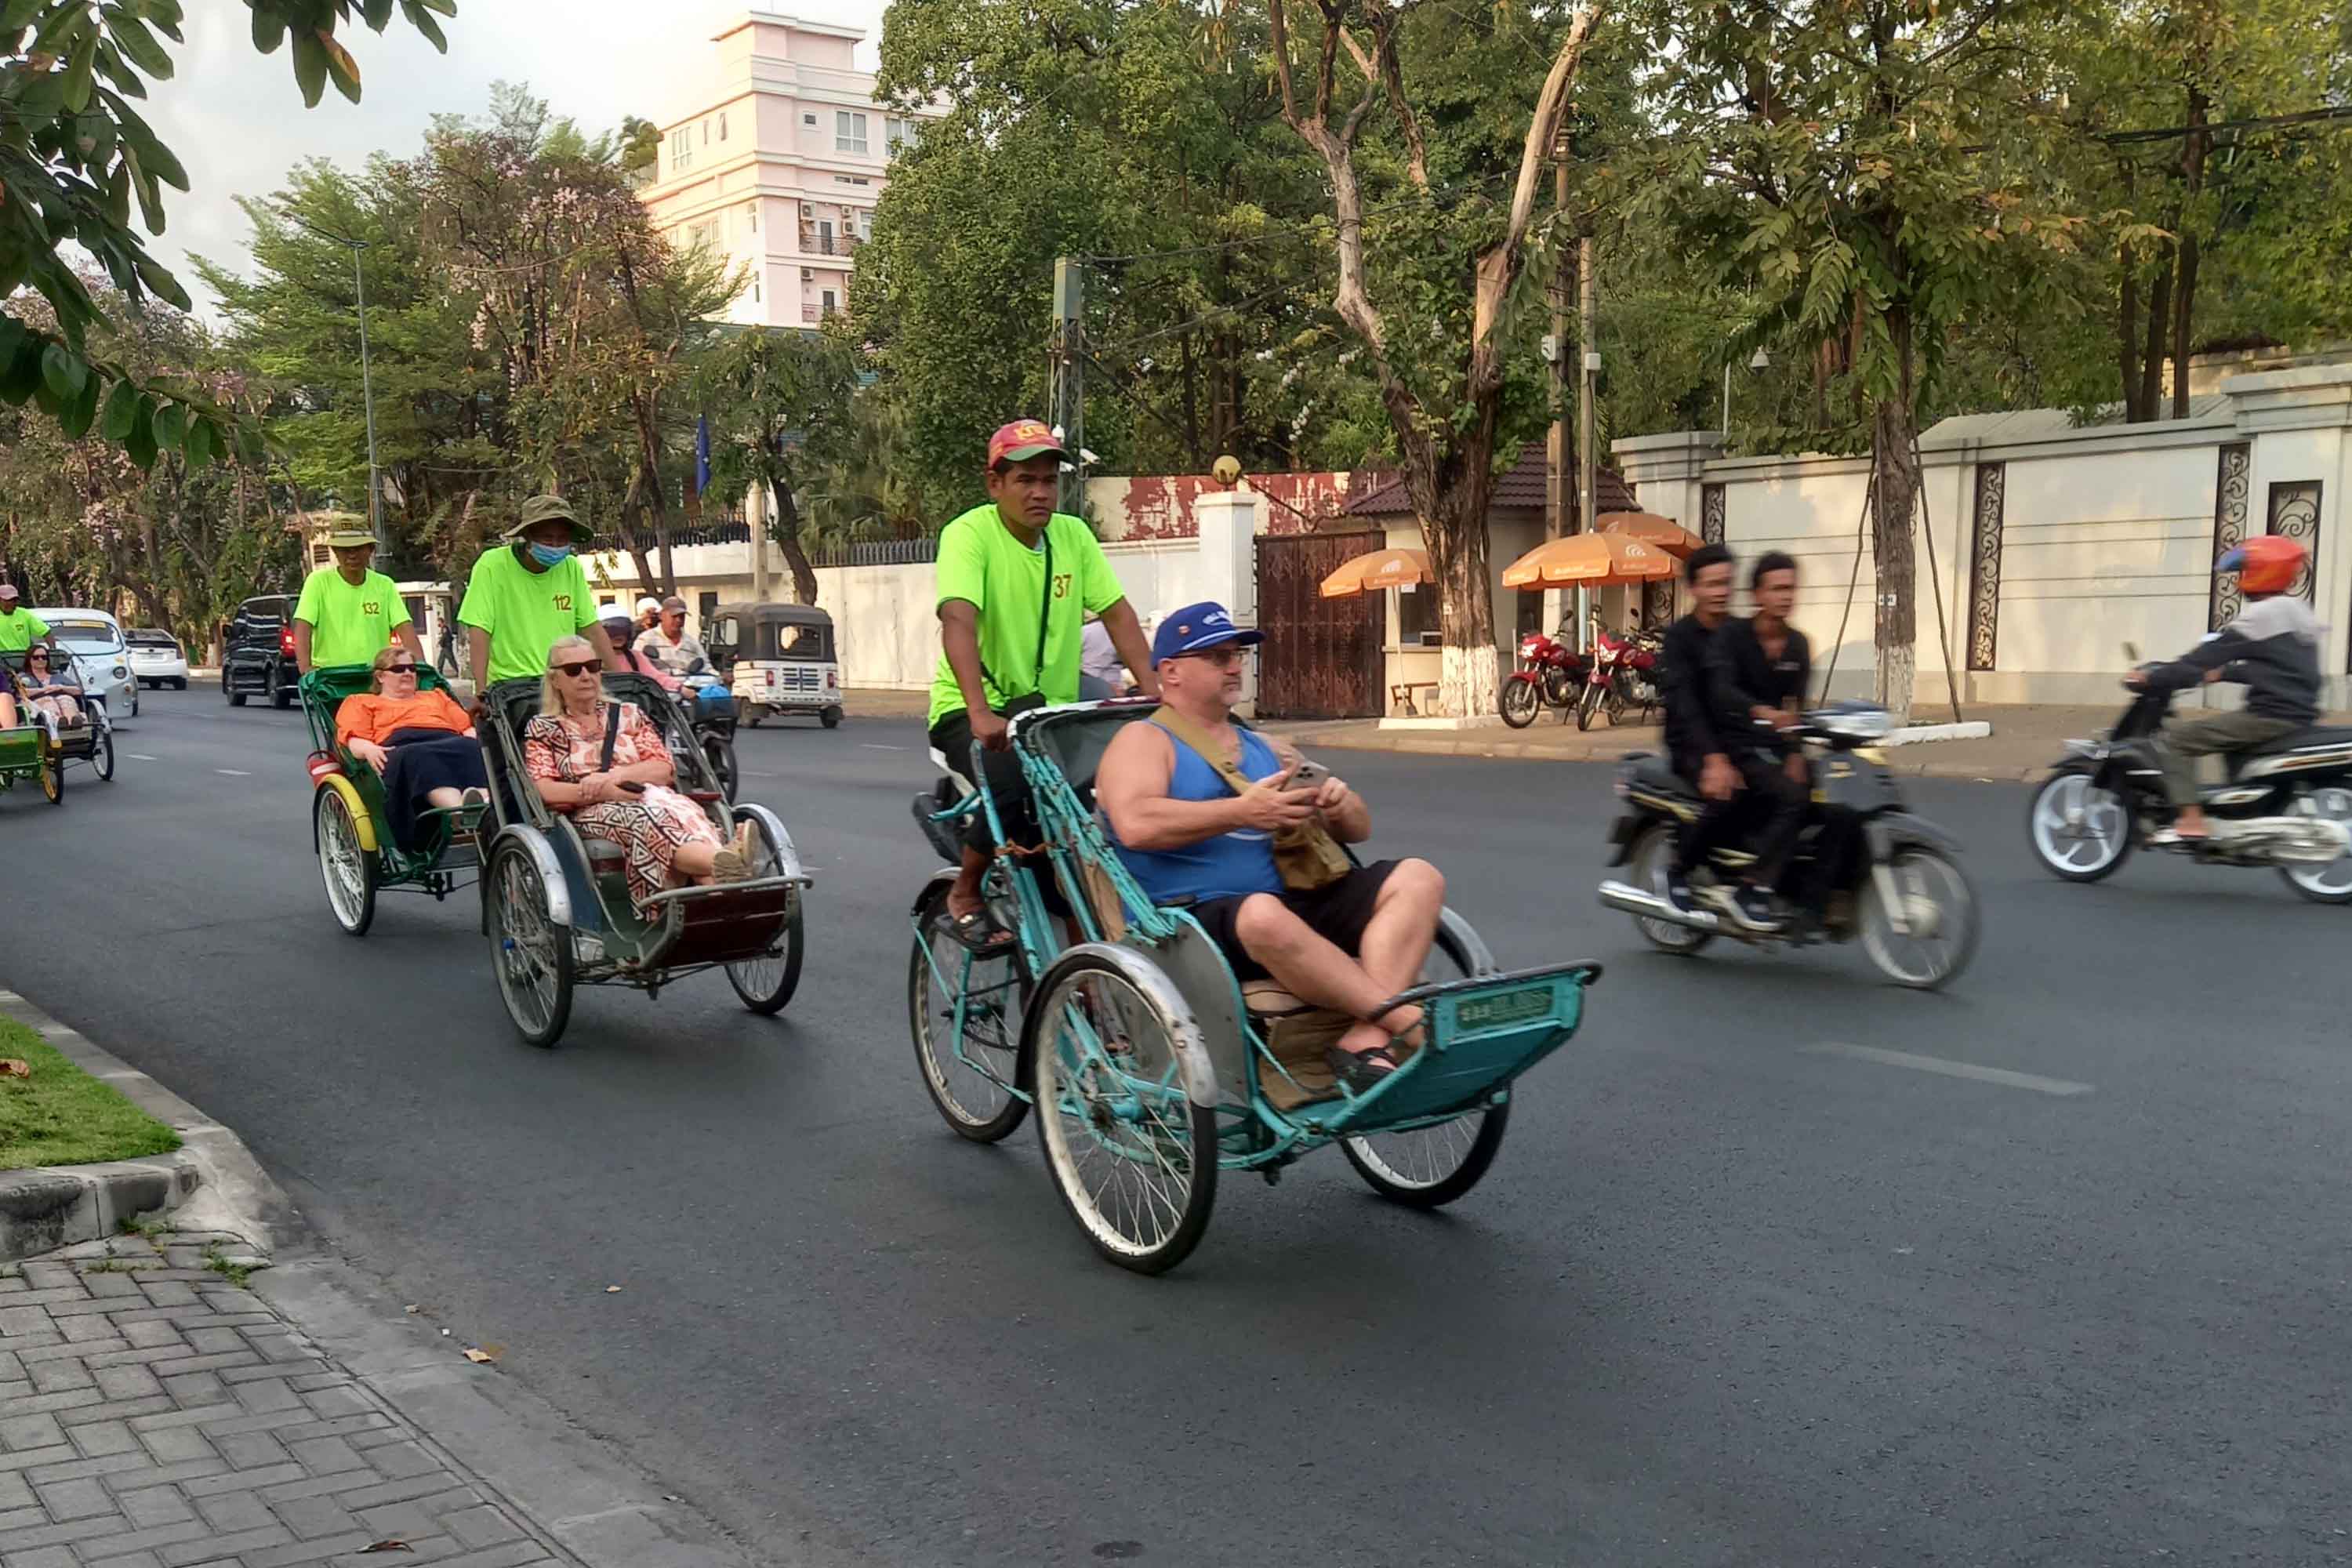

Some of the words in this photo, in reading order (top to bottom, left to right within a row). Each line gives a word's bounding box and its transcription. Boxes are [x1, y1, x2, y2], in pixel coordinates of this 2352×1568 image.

[1054, 575, 1072, 598] 37
[362, 602, 379, 615] 132
[552, 595, 572, 610] 112
